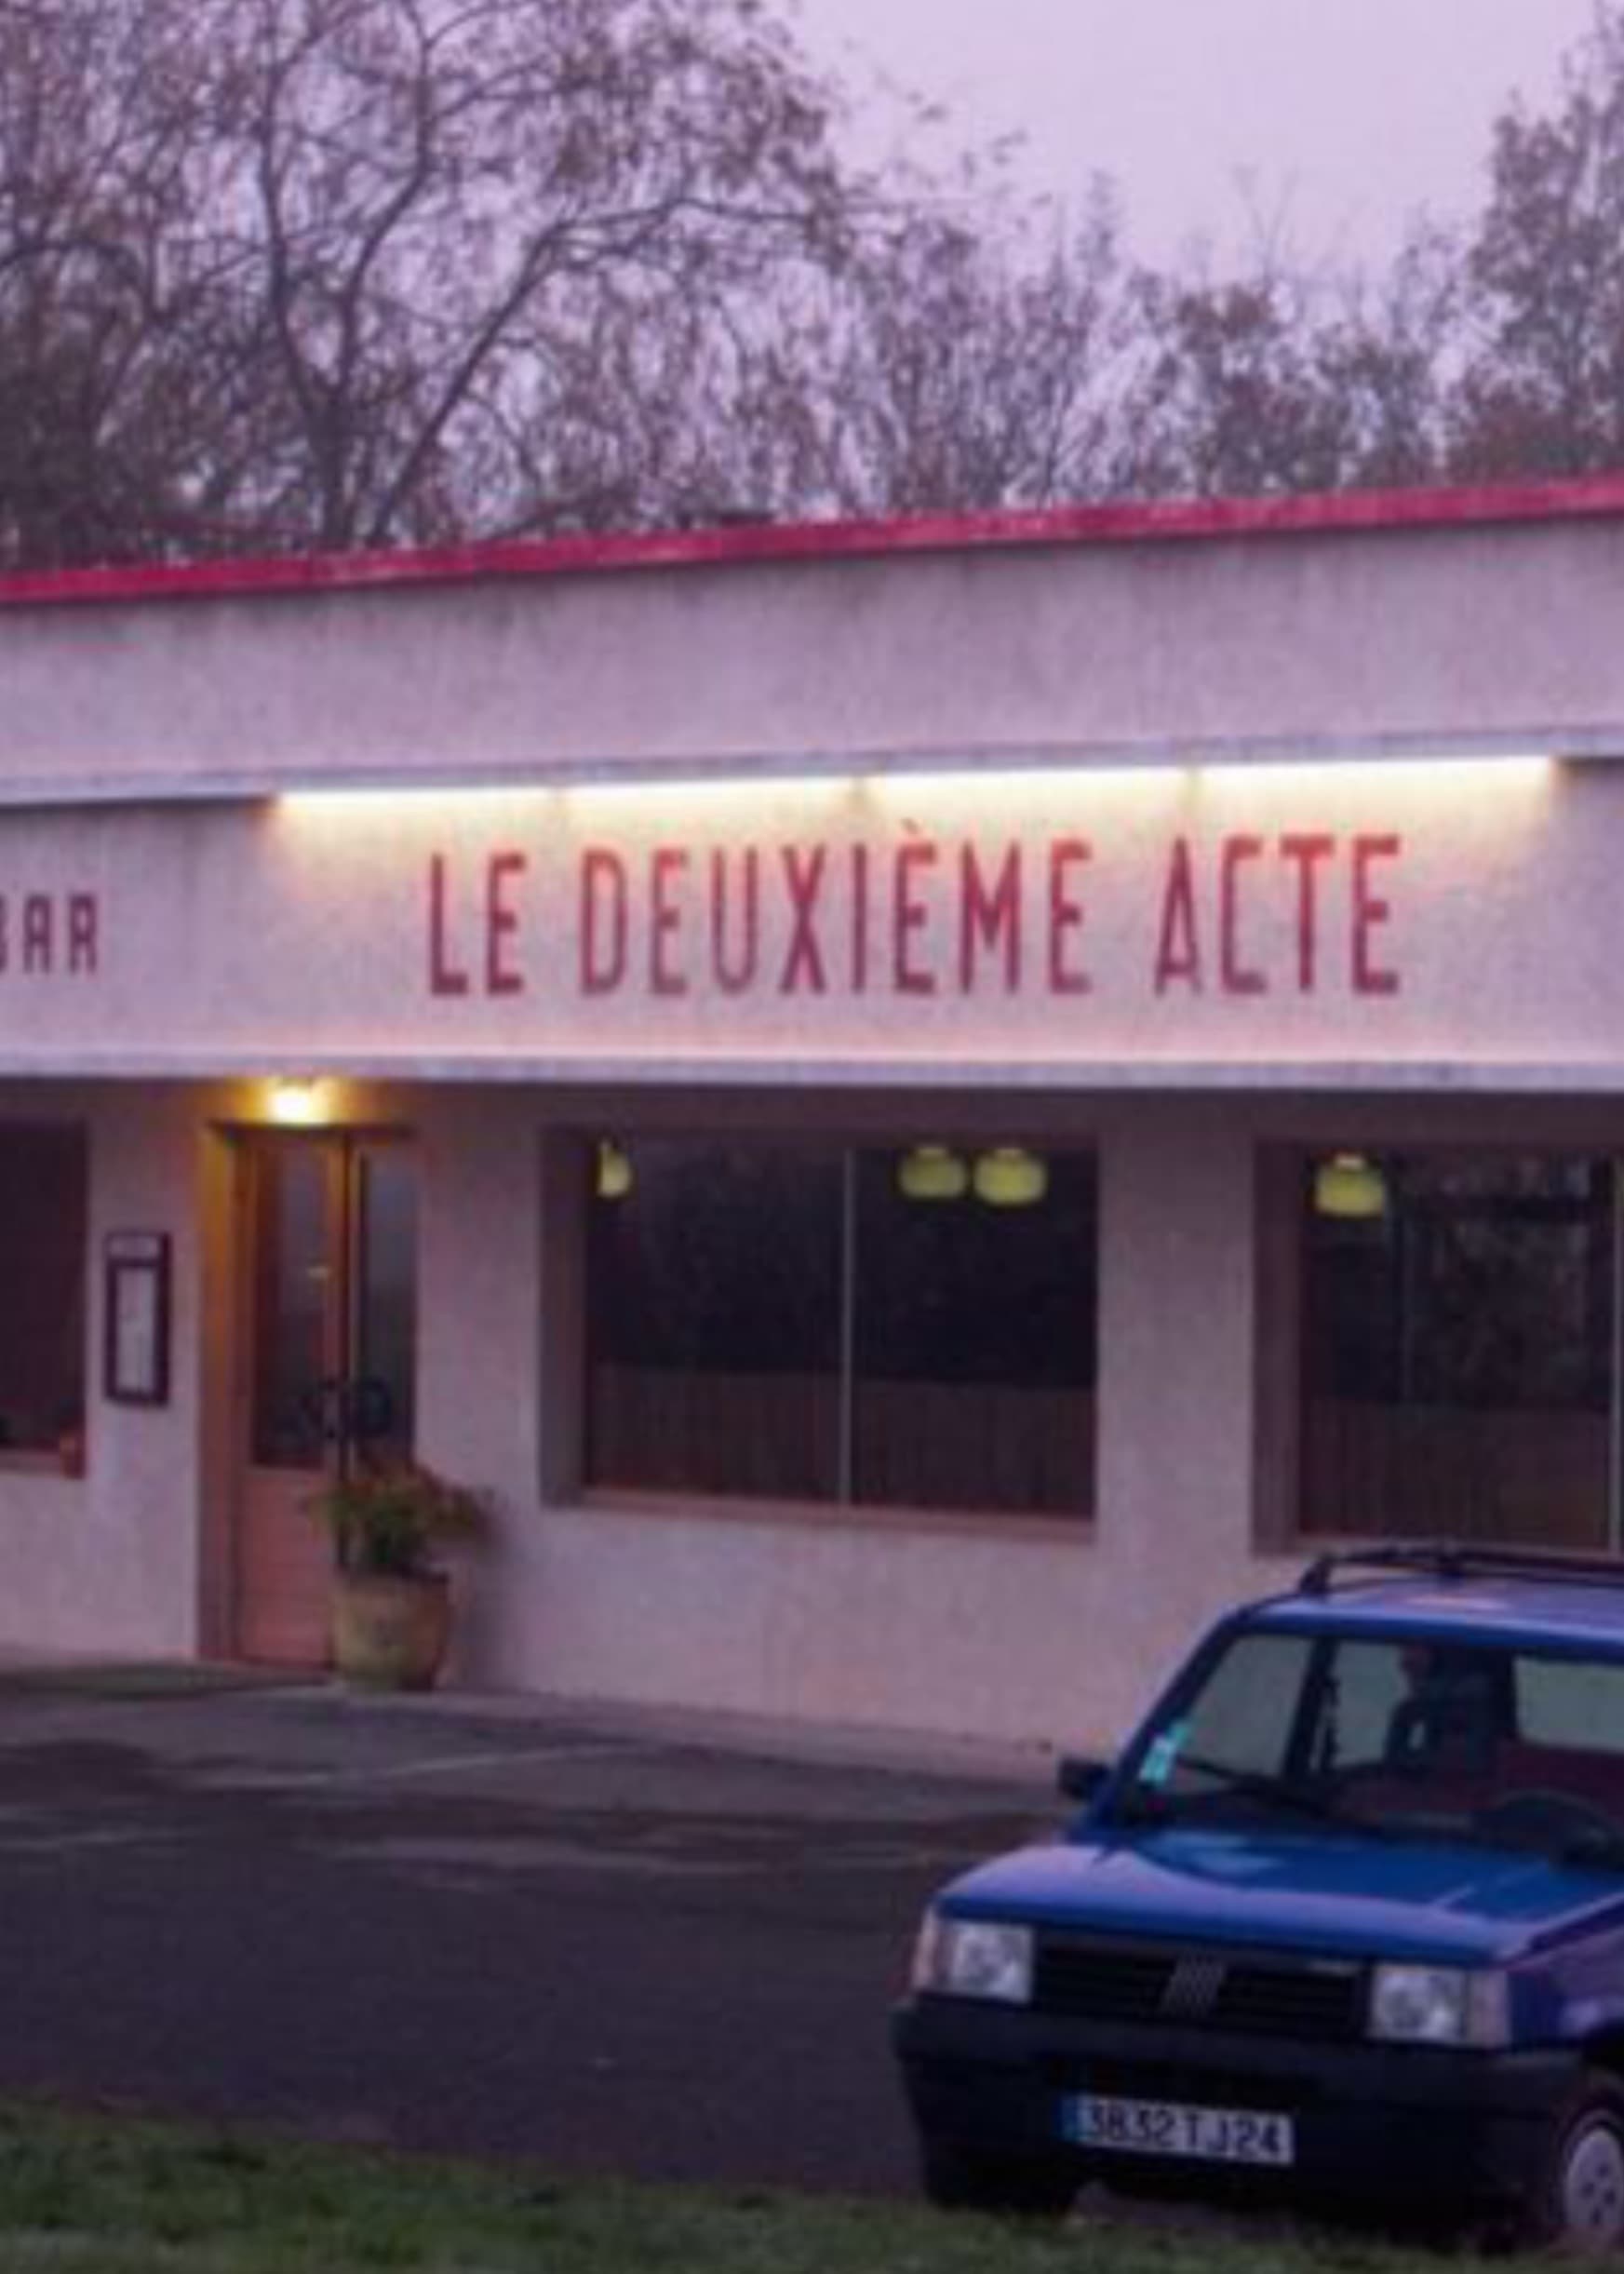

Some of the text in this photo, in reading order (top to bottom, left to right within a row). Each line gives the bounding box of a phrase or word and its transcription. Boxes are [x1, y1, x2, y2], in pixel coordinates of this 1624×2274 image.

[427, 819, 1401, 997] LE DEUXIÈME ACTE
